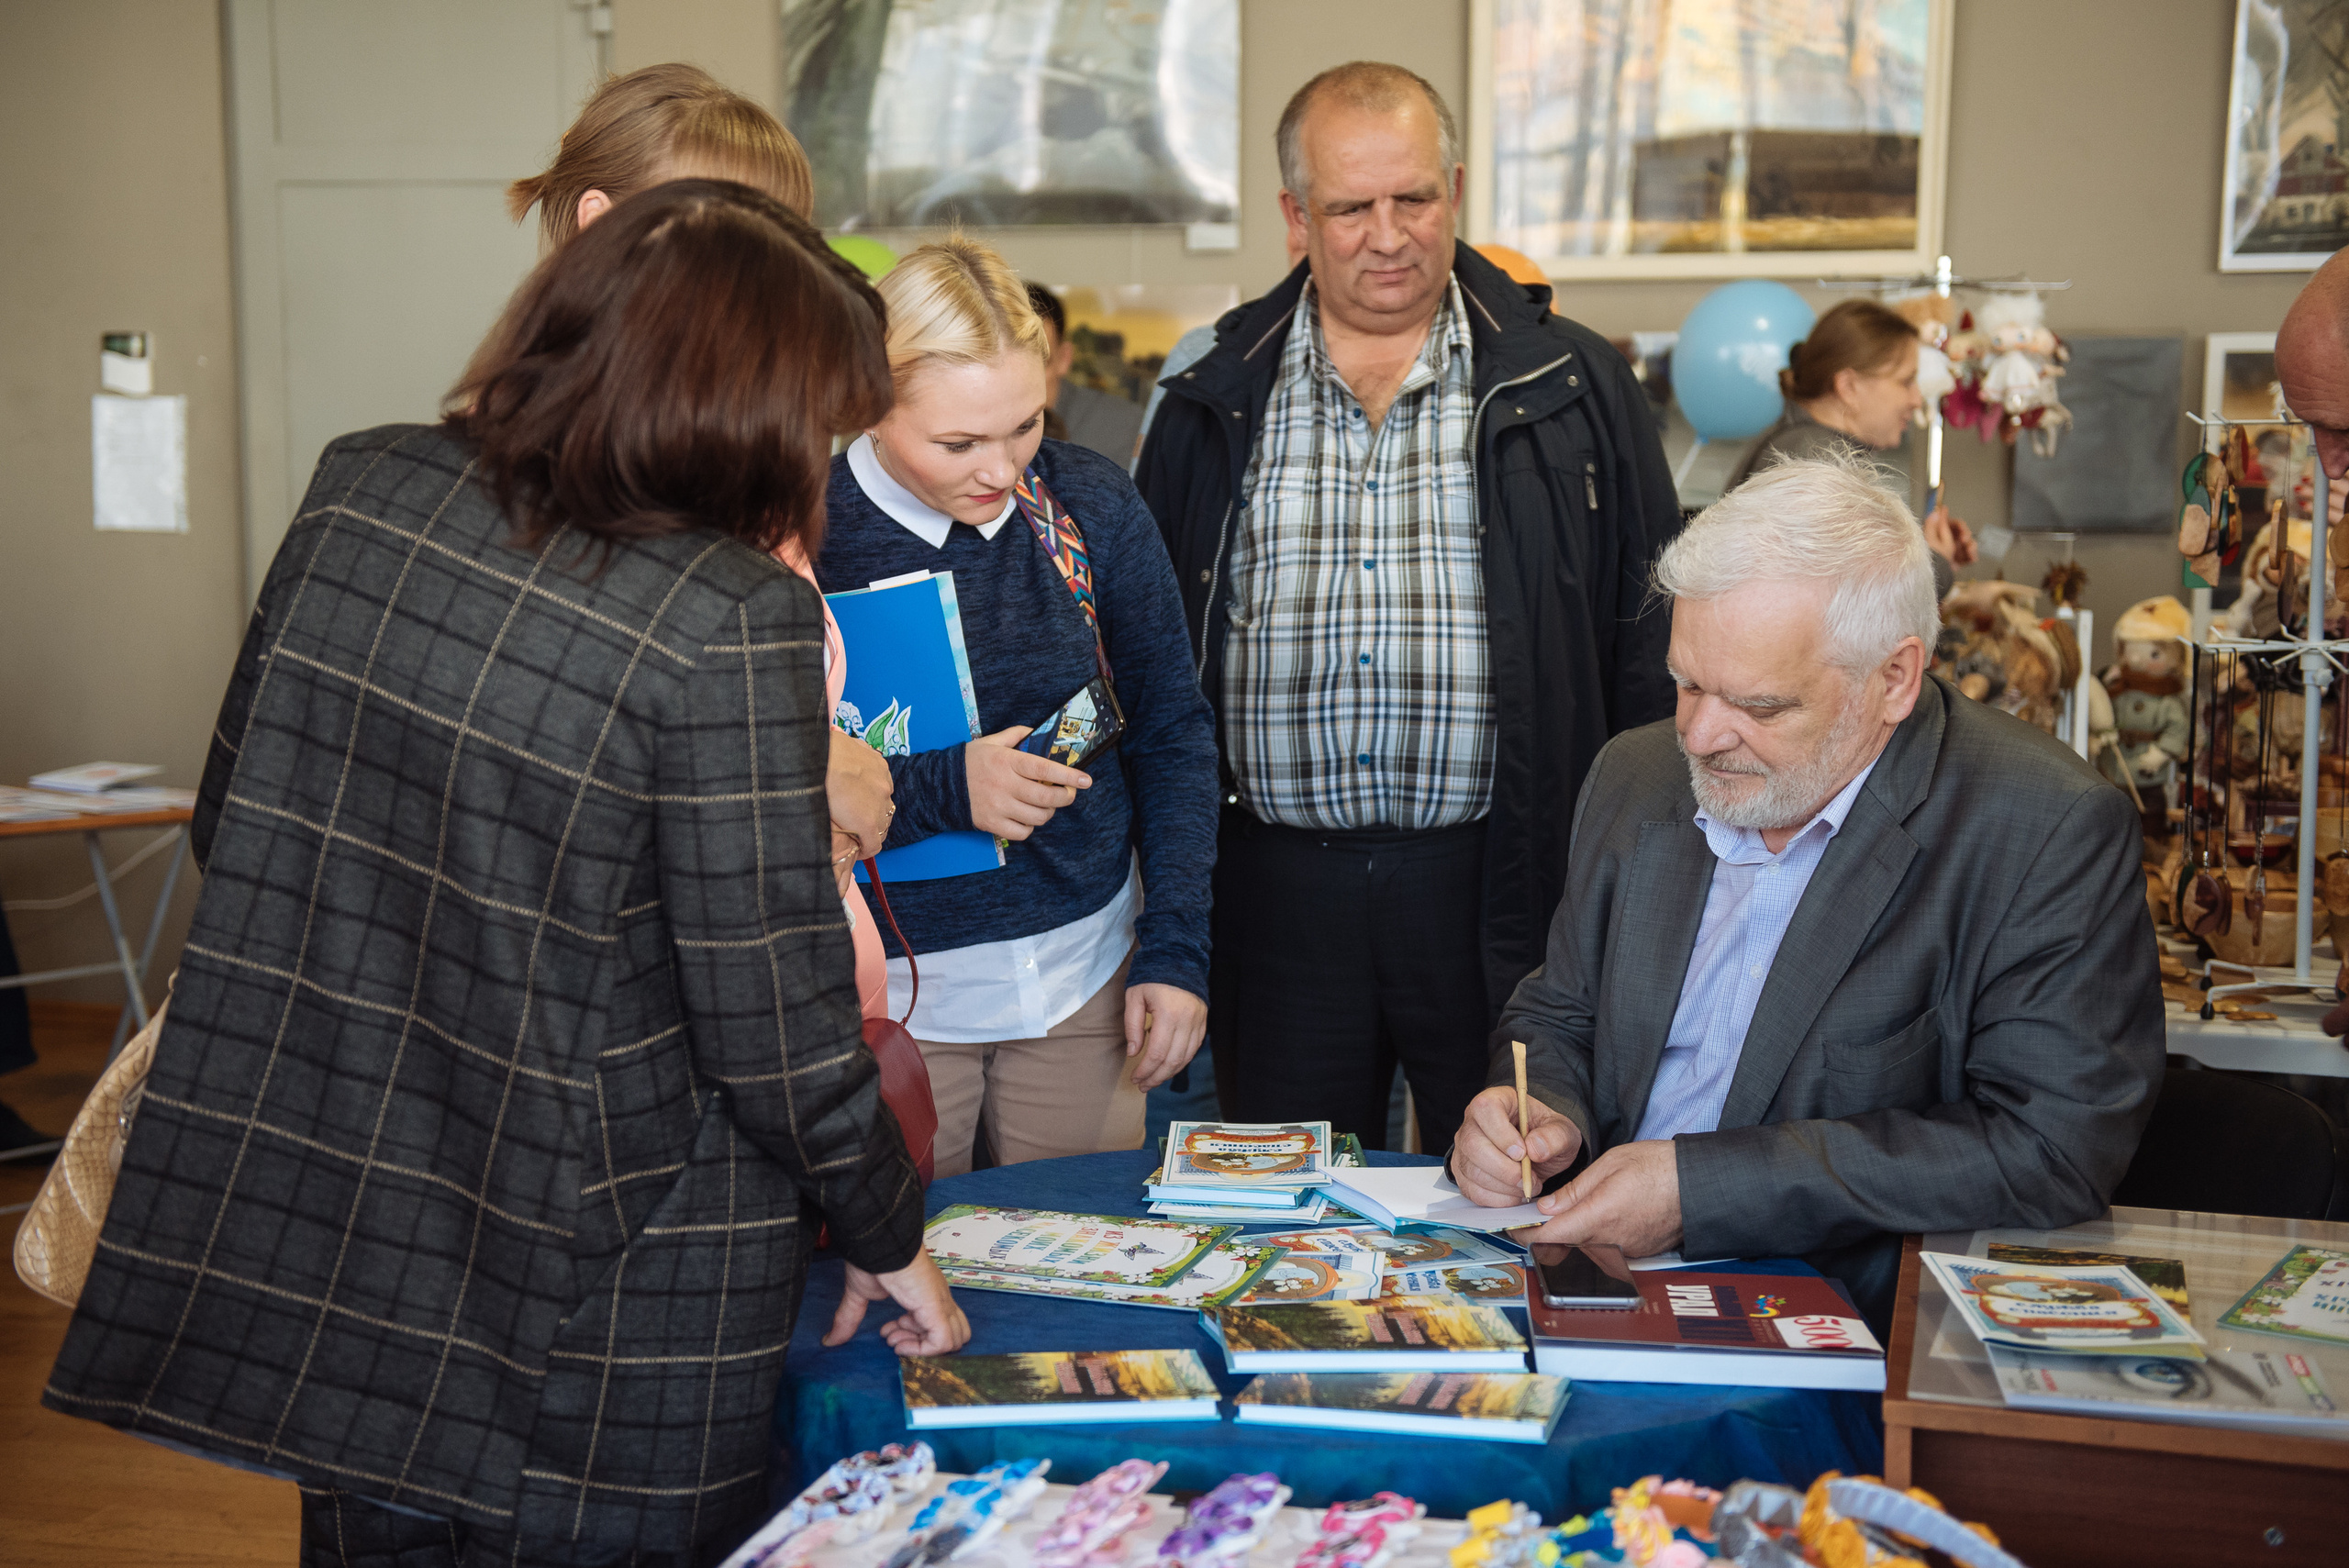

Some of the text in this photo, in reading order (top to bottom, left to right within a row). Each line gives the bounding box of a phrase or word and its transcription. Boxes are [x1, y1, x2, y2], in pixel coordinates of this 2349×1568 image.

[988, 1221, 1058, 1261] НАСЕКОМЫХ
[1038, 1226, 1099, 1264] ЗНАКОМЫХ
[1066, 1229, 1124, 1265] ИЗ ЖИЗНИ
[1664, 1284, 1720, 1318] УРАЛ
[1793, 1316, 1854, 1348] 500
